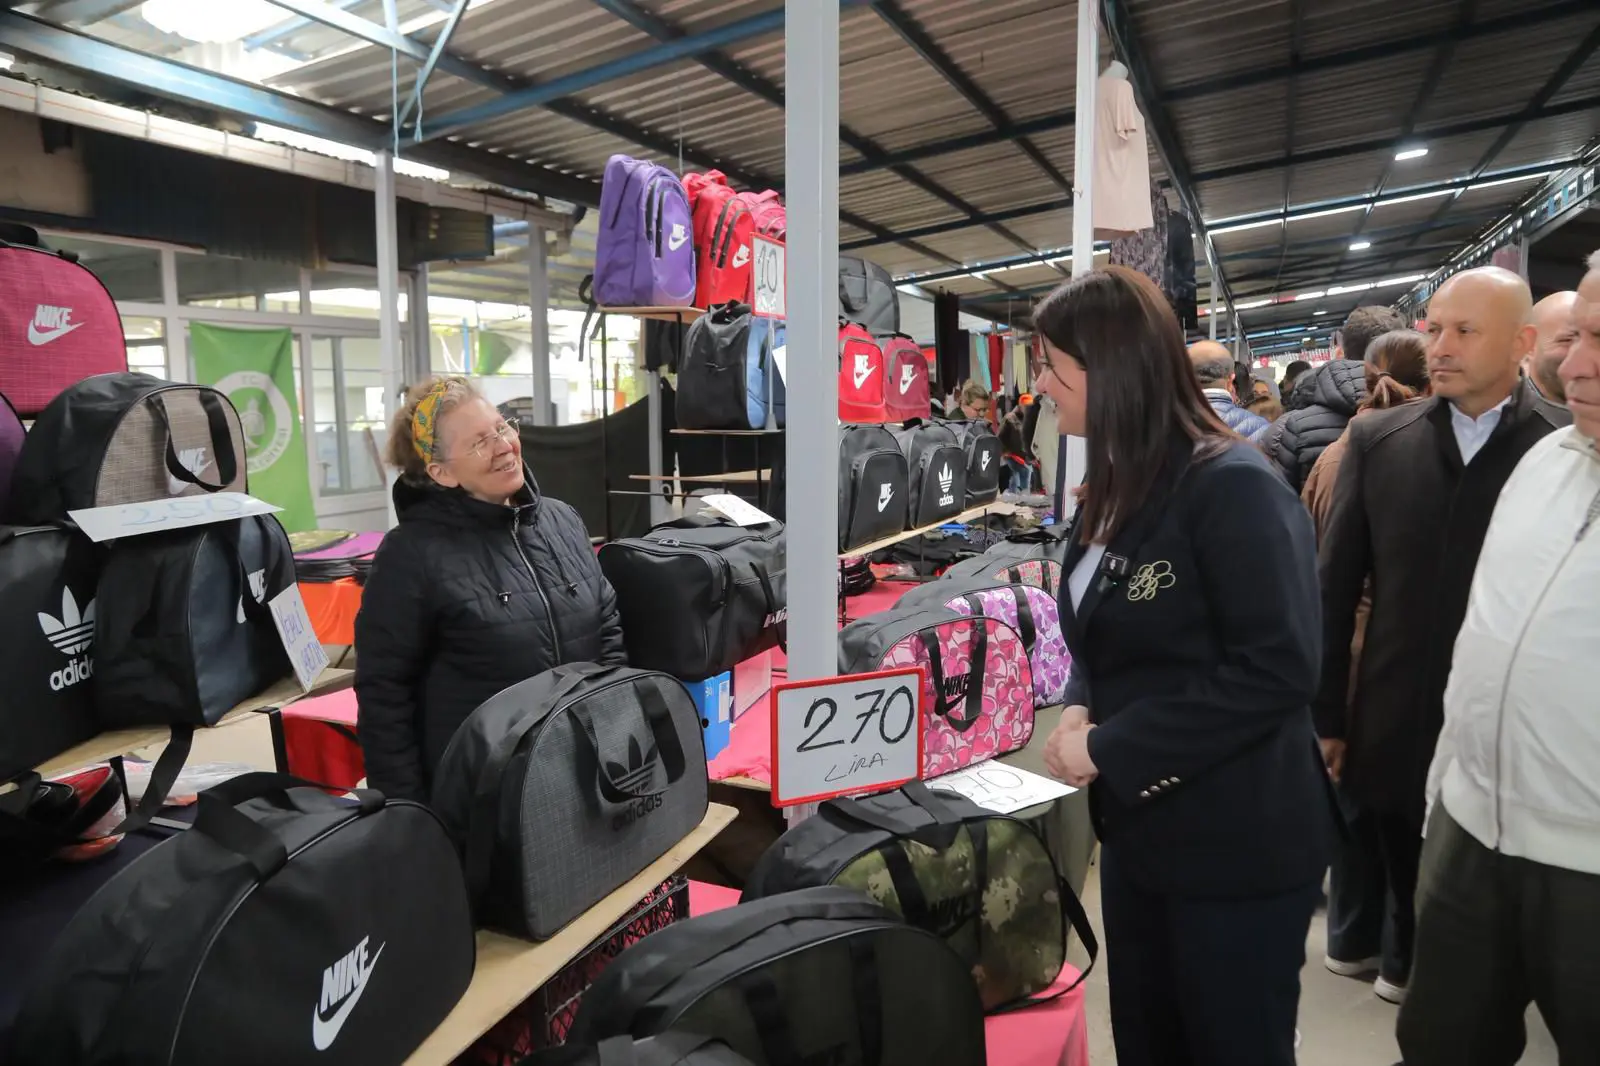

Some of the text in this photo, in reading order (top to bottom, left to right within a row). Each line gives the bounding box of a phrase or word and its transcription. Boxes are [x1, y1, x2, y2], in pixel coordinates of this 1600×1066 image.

[35, 304, 73, 329] NIKE
[938, 494, 955, 507] adidas
[943, 672, 969, 697] NIKE
[796, 685, 915, 752] 270
[612, 793, 663, 832] adidas
[319, 934, 369, 1014] NIKE
